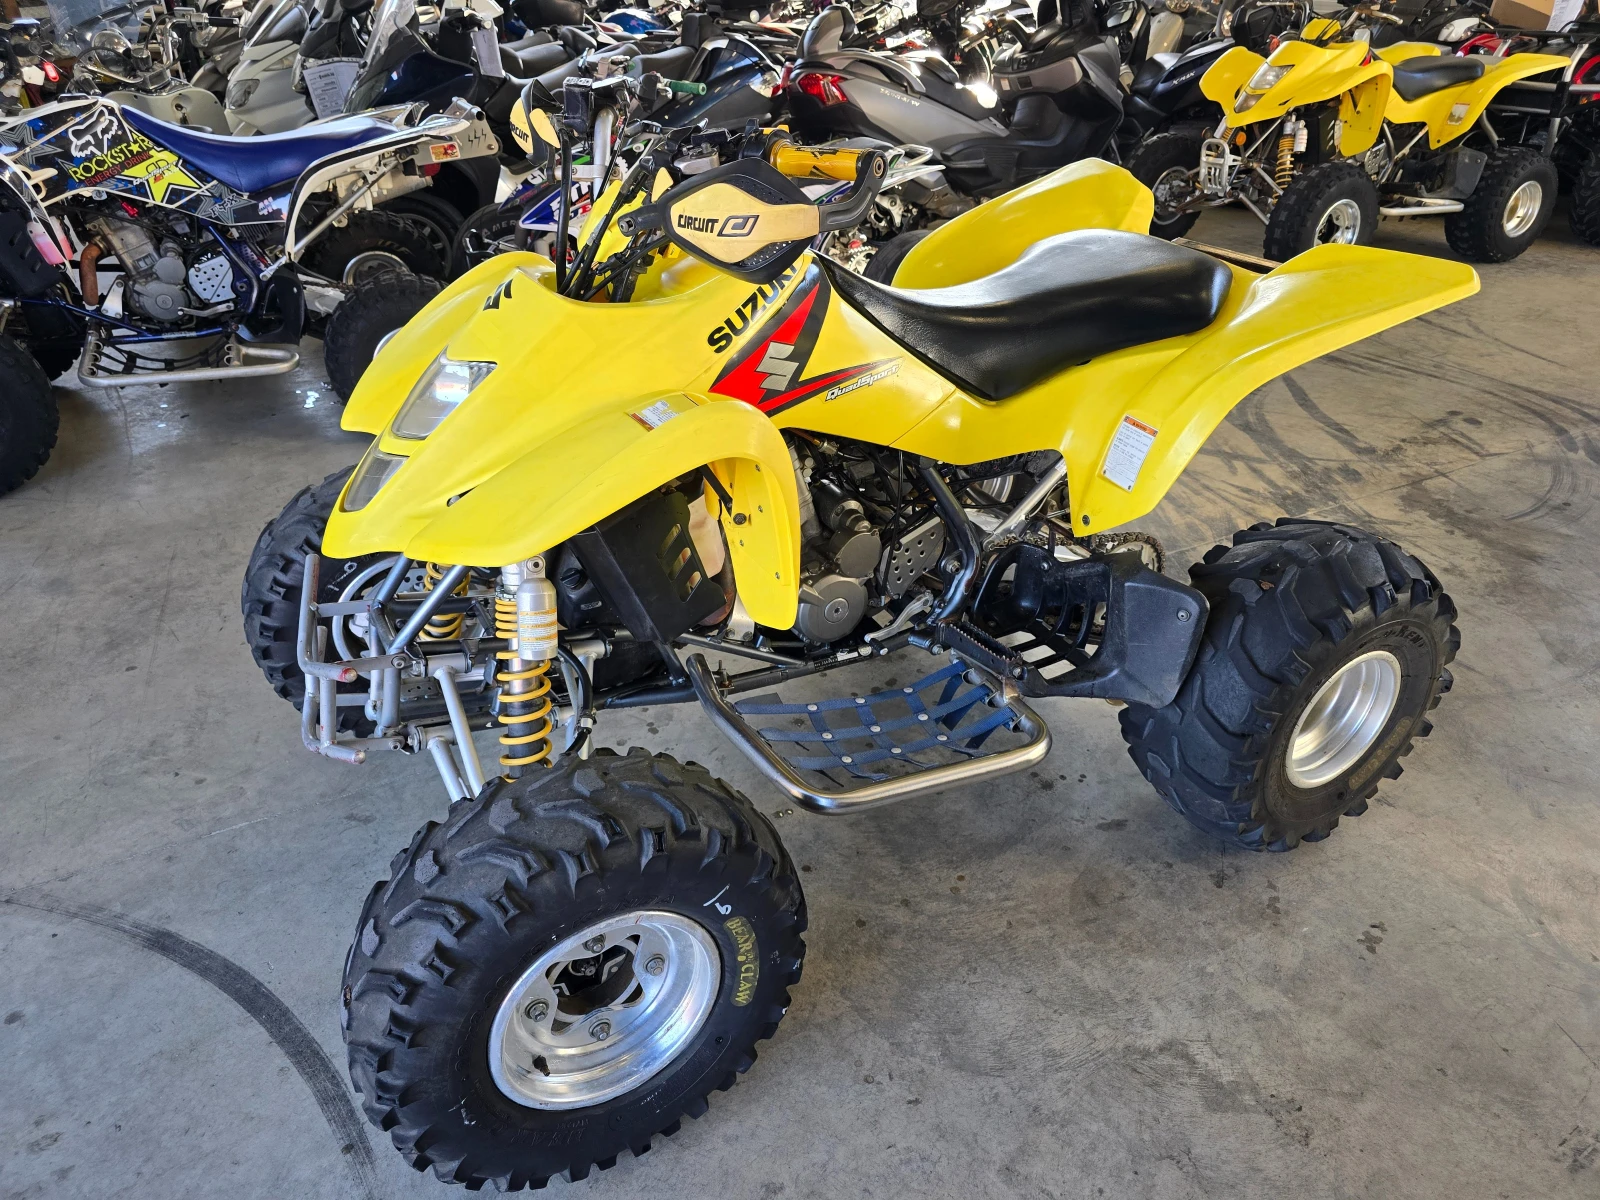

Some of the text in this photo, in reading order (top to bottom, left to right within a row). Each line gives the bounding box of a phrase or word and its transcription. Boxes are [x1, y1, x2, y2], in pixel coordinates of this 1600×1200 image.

[84, 151, 151, 187] ENERGY DRINK
[677, 214, 719, 234] CIRCUIT
[826, 364, 899, 401] QuadSport
[726, 918, 755, 1003] BEAR CLAW
